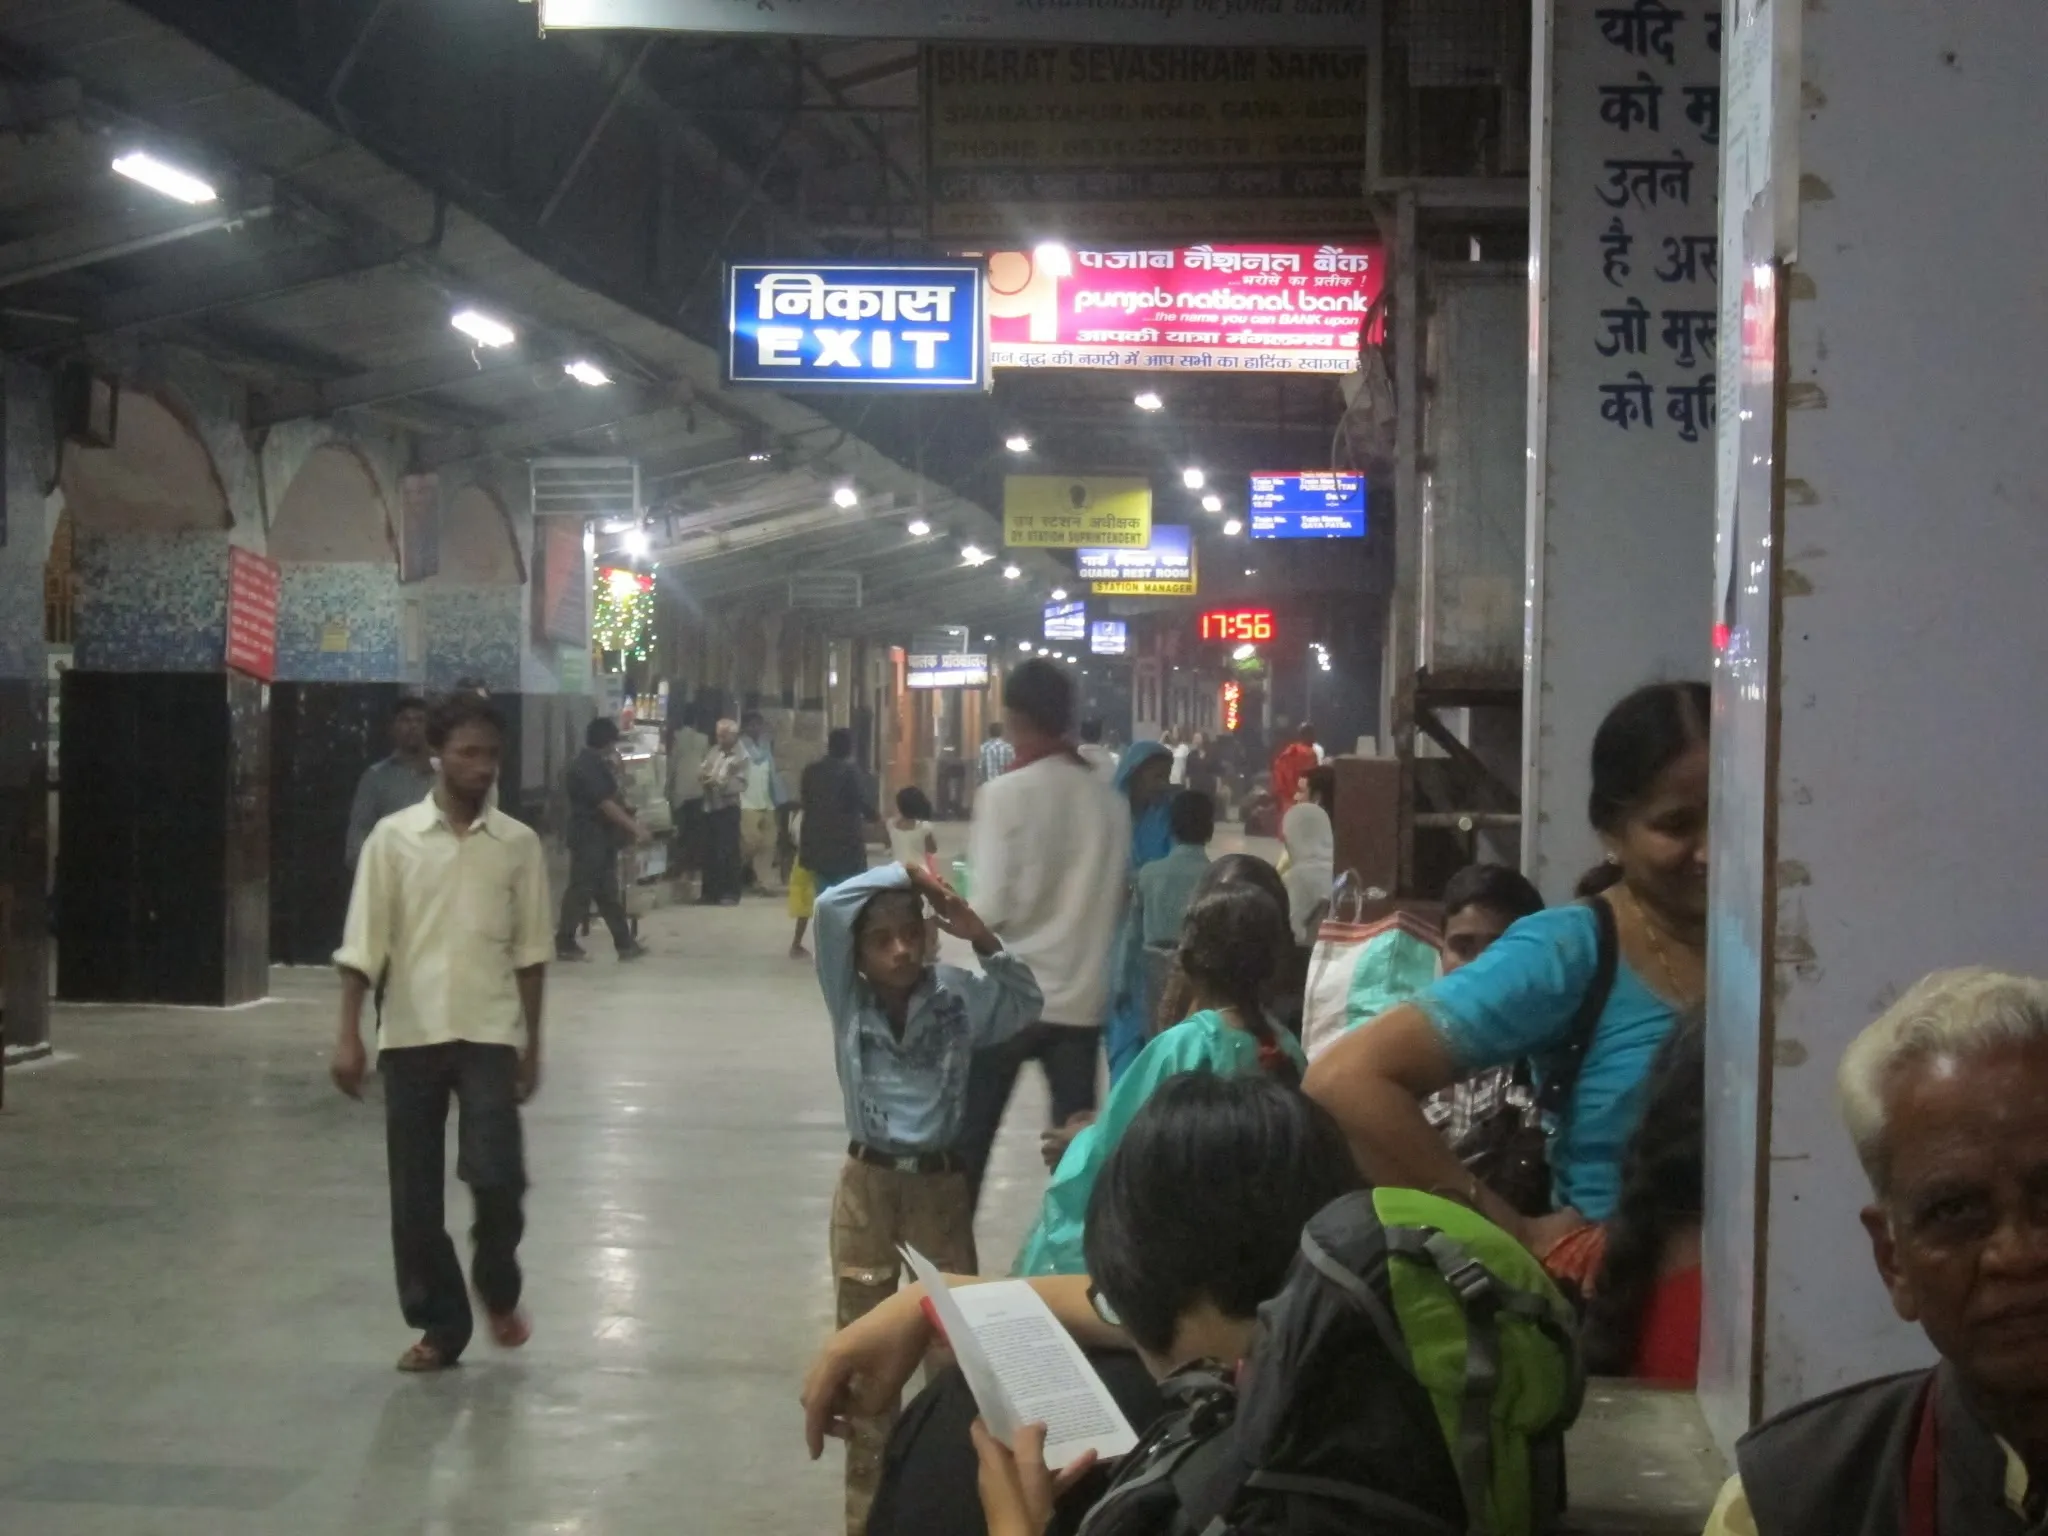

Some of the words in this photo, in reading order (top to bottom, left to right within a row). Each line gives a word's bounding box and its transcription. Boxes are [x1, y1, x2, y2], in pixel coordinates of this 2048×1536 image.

[1595, 0, 1684, 65] यदि
[1069, 47, 1256, 83] SEVASHRAM
[1598, 71, 1662, 132] को
[1594, 149, 1694, 210] उतने
[1313, 244, 1369, 273] बैंक
[1599, 216, 1633, 288] है
[1288, 275, 1309, 287] का
[1313, 273, 1354, 288] प्रतीक
[754, 273, 956, 322] निकास
[1074, 286, 1174, 314] punjab
[1175, 288, 1295, 311] national
[1298, 290, 1369, 313] bank
[1075, 326, 1160, 343] आपकी
[1180, 313, 1220, 323] name
[1221, 314, 1248, 325] you
[1250, 314, 1276, 324] can
[1278, 314, 1322, 325] BANK
[1323, 315, 1360, 327] upon
[1595, 297, 1651, 357] जो
[757, 327, 950, 369] EXIT
[1018, 352, 1047, 367] बुद्ध
[1051, 350, 1075, 365] की
[1077, 350, 1121, 366] नगरी
[1123, 350, 1140, 366] में
[1143, 354, 1174, 367] आप
[1178, 352, 1212, 368] सभी
[1217, 355, 1239, 369] का
[1297, 356, 1351, 371] स्वागत
[1599, 371, 1653, 430] को
[1079, 568, 1119, 578] GUARD
[1122, 568, 1153, 578] REST
[1155, 568, 1190, 578] ROOM
[1096, 581, 1139, 592] STATION
[1143, 583, 1193, 593] MANAGER
[1203, 614, 1272, 639] 17:56
